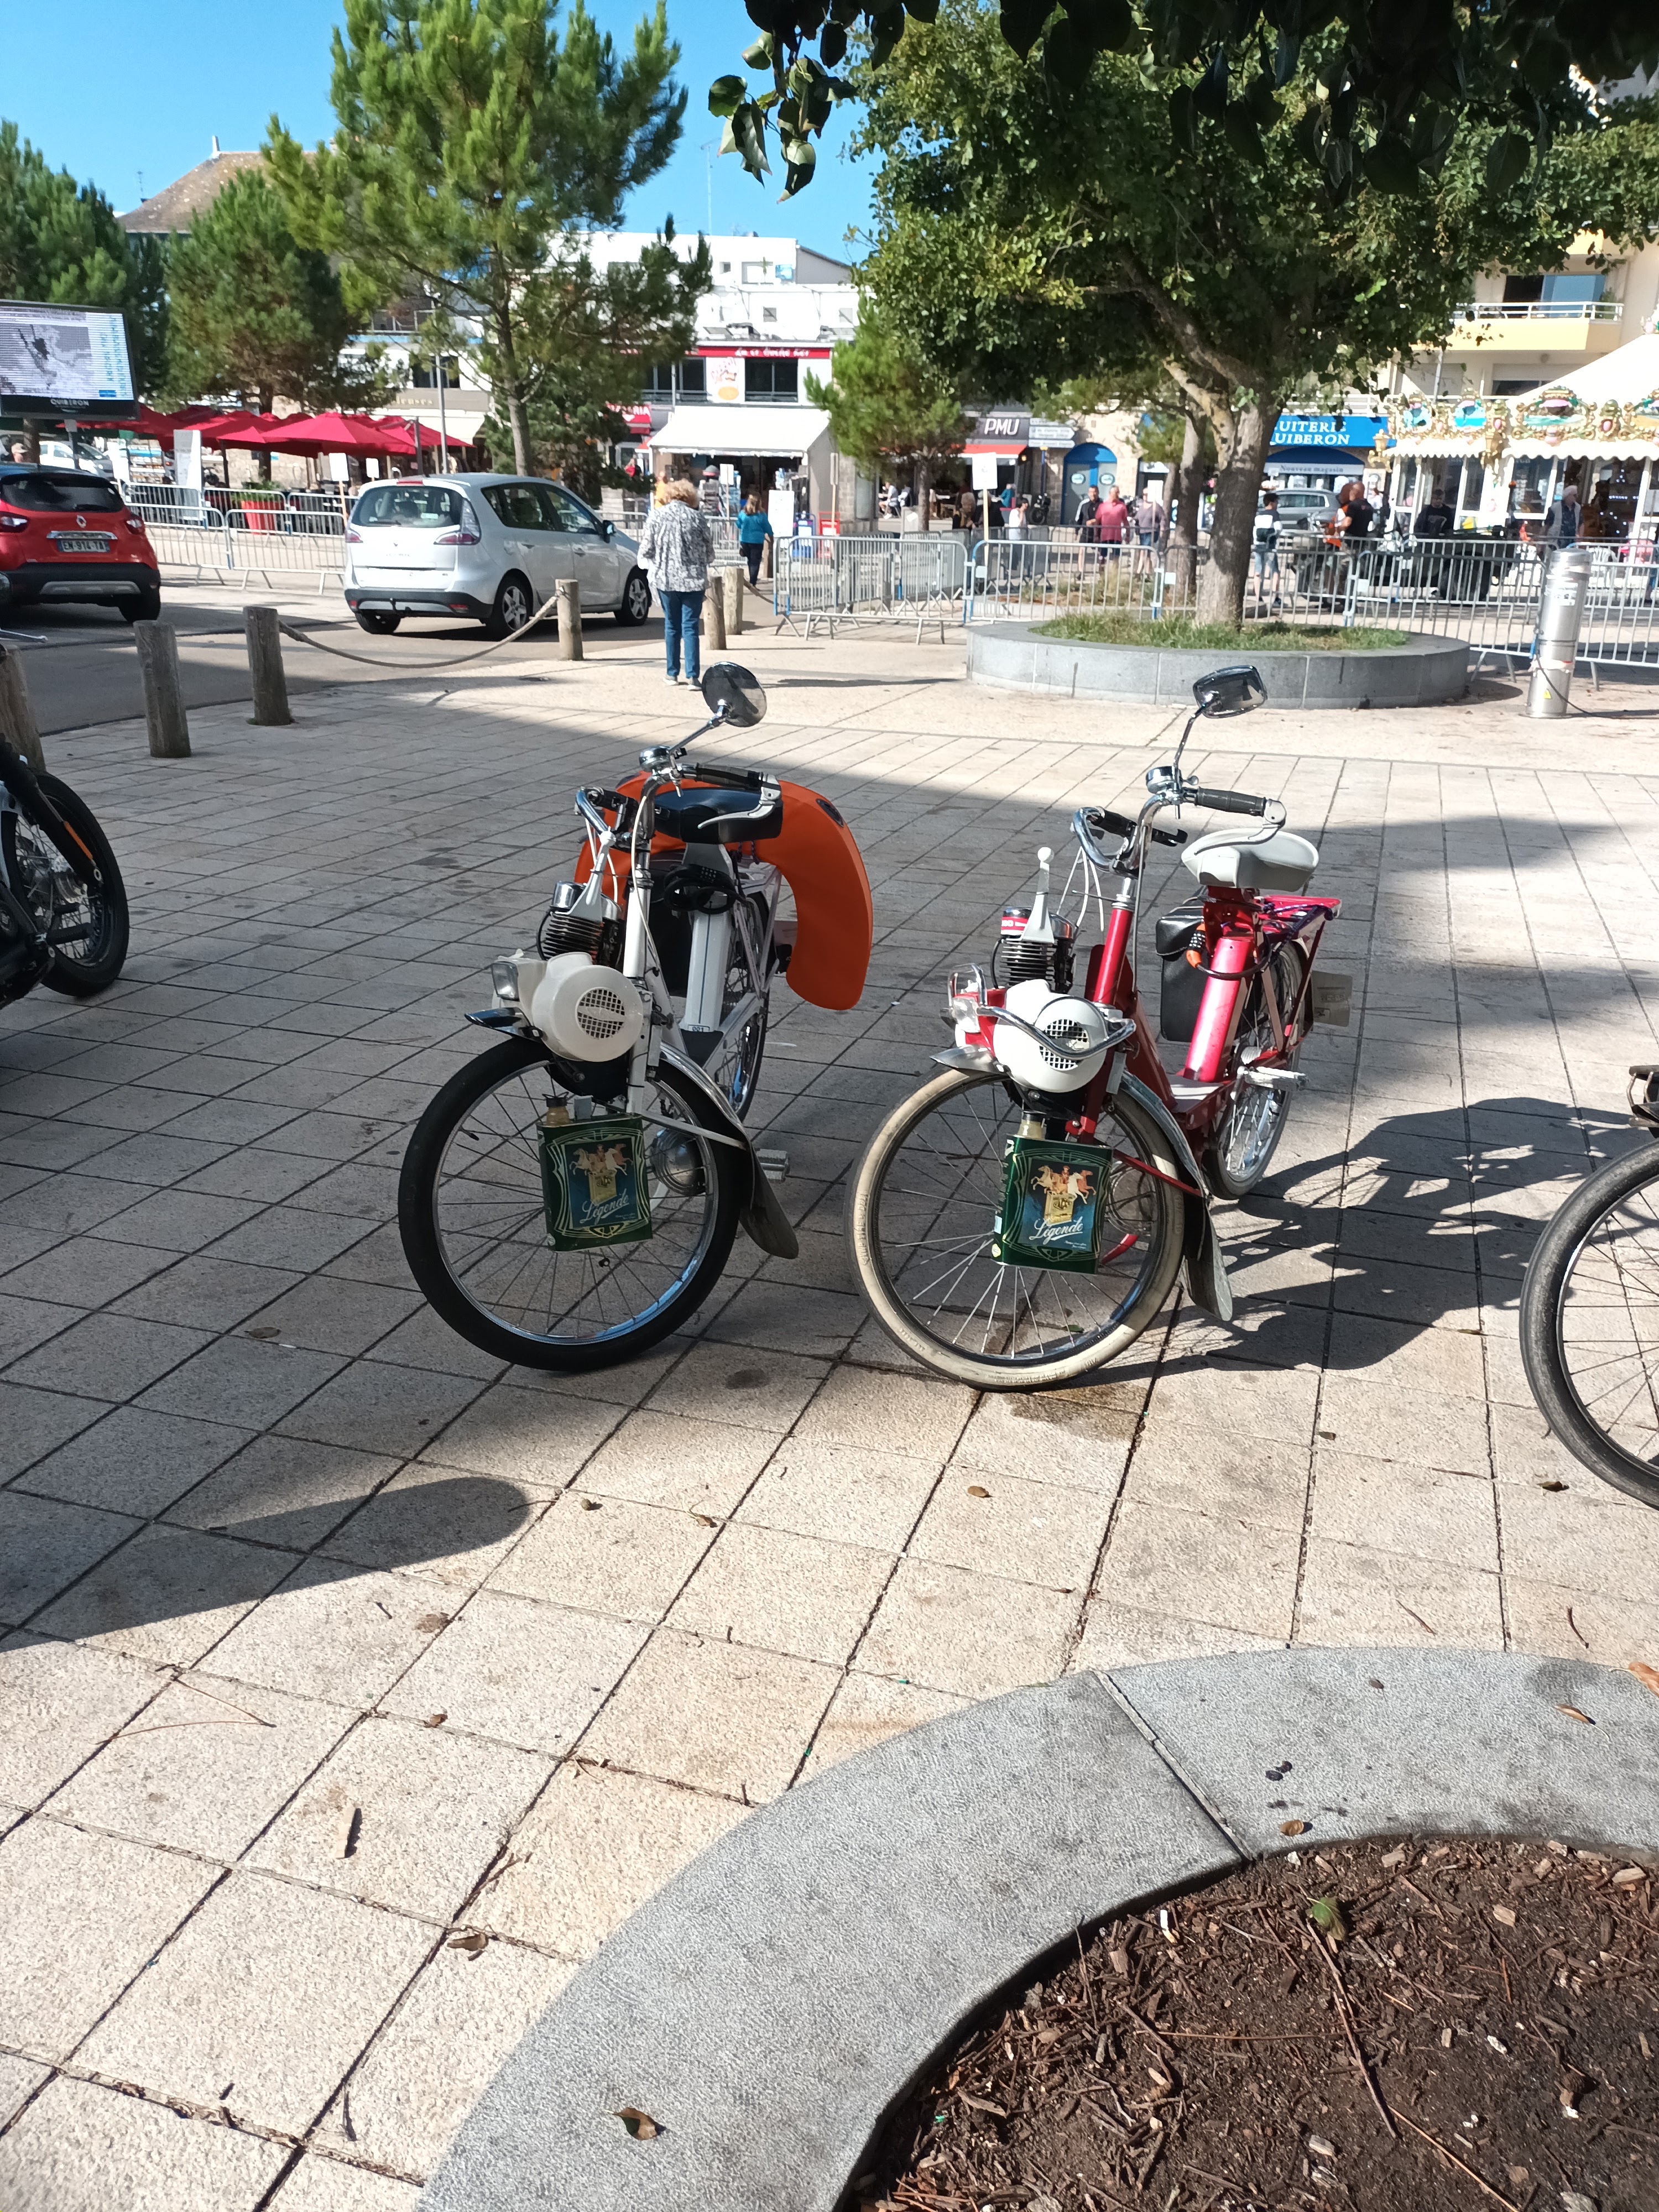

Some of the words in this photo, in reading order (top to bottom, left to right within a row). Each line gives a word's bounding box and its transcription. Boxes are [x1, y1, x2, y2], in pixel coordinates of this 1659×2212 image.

[984, 419, 1020, 435] PMU
[1274, 421, 1347, 432] UITERI
[1270, 432, 1350, 446] UIBERON
